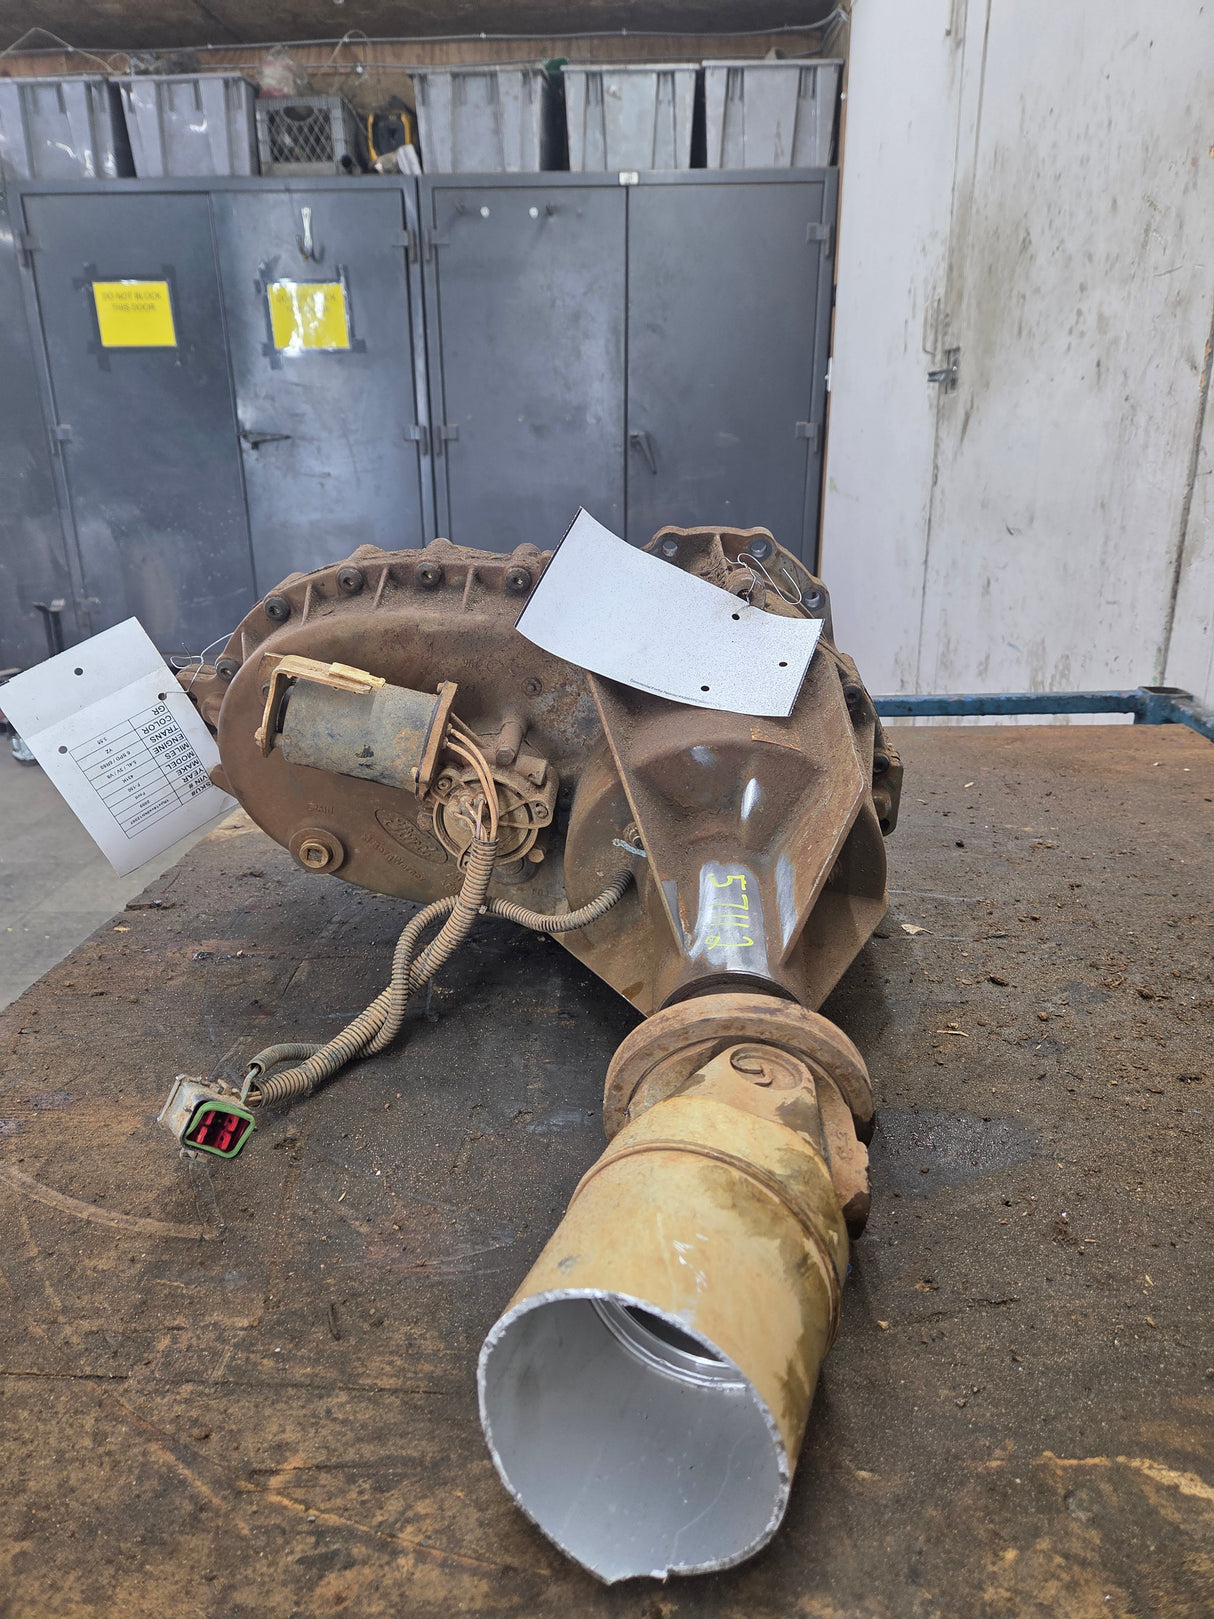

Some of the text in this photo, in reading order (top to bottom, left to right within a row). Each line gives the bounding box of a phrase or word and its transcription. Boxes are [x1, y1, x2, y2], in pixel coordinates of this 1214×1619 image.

[151, 704, 166, 715] GR
[141, 713, 172, 734] COLOR
[149, 723, 178, 743] TRANS
[151, 732, 183, 754] ENGINE
[164, 741, 189, 759] MILES
[165, 750, 194, 771] MODEL
[175, 758, 199, 776] MAKE
[181, 766, 203, 783] YEAR
[194, 774, 207, 784] VIN
[705, 873, 755, 951] 57112
